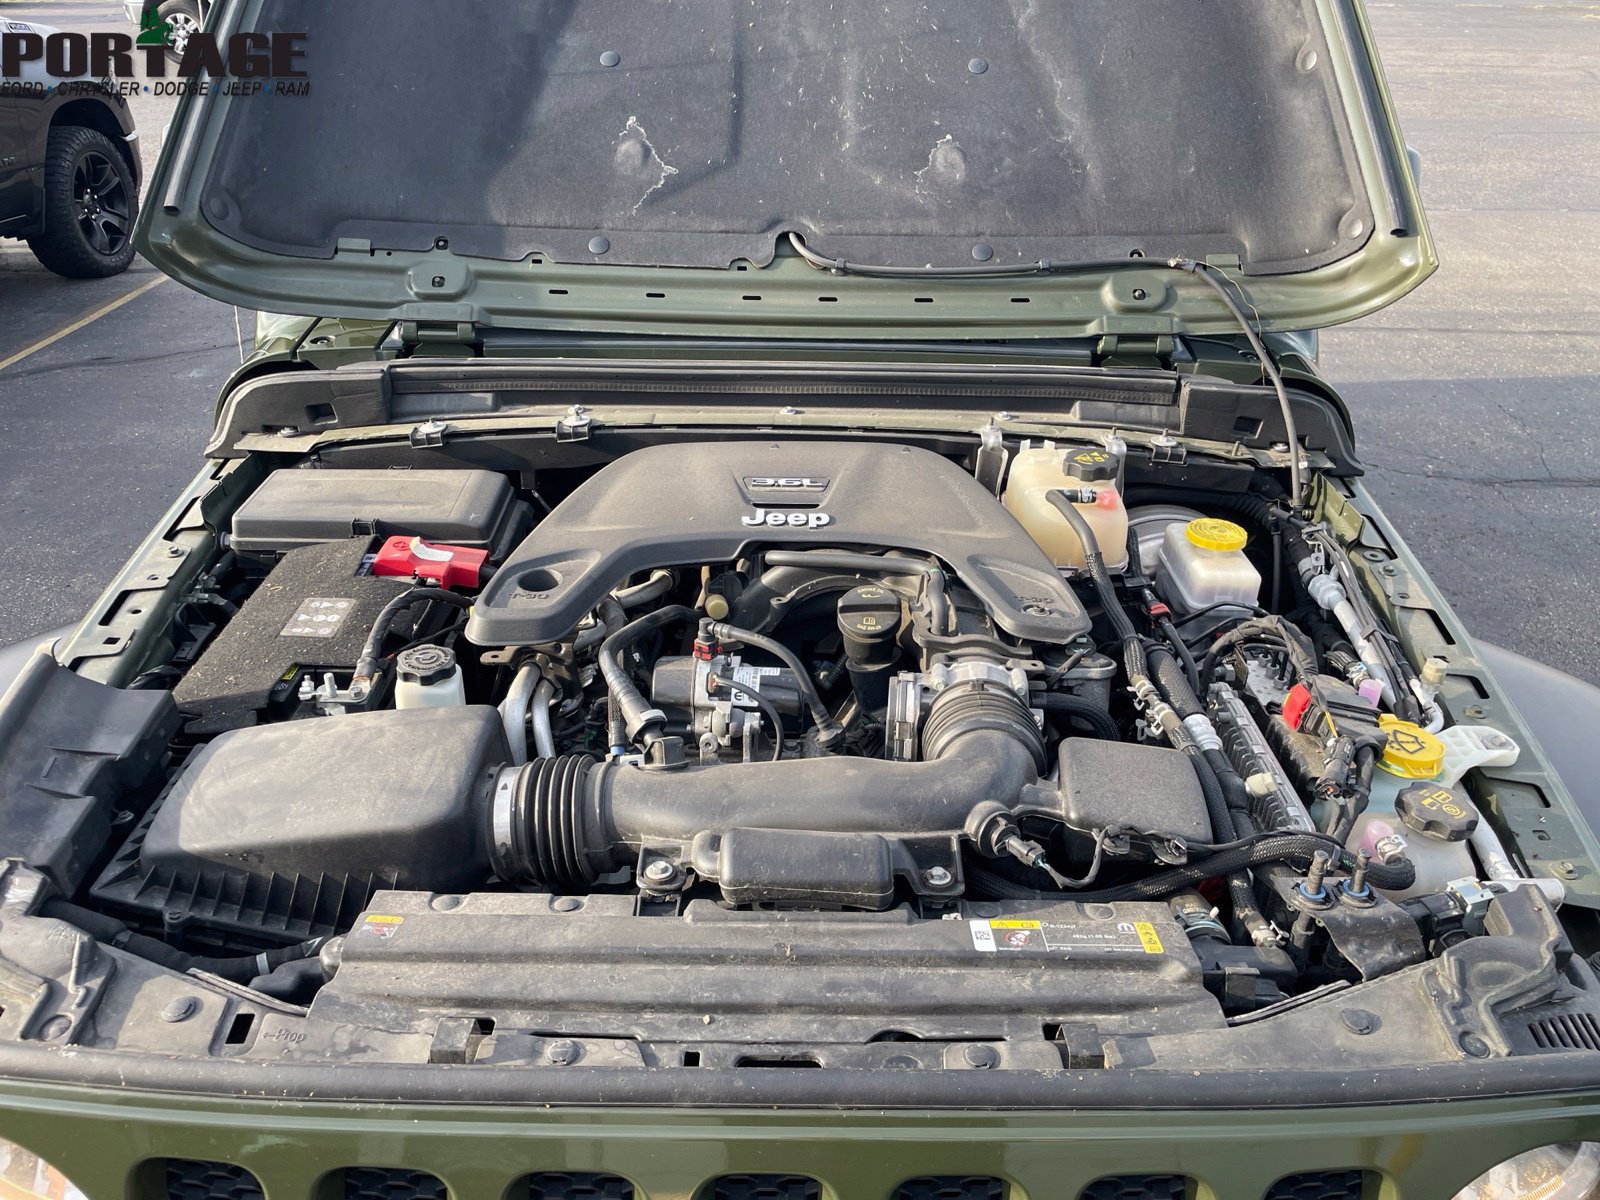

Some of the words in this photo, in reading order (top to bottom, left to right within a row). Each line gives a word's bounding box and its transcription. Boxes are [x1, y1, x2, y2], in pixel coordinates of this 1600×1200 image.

[751, 478, 824, 488] 3.6L
[741, 508, 831, 529] Jeep
[275, 1028, 305, 1045] Prop
